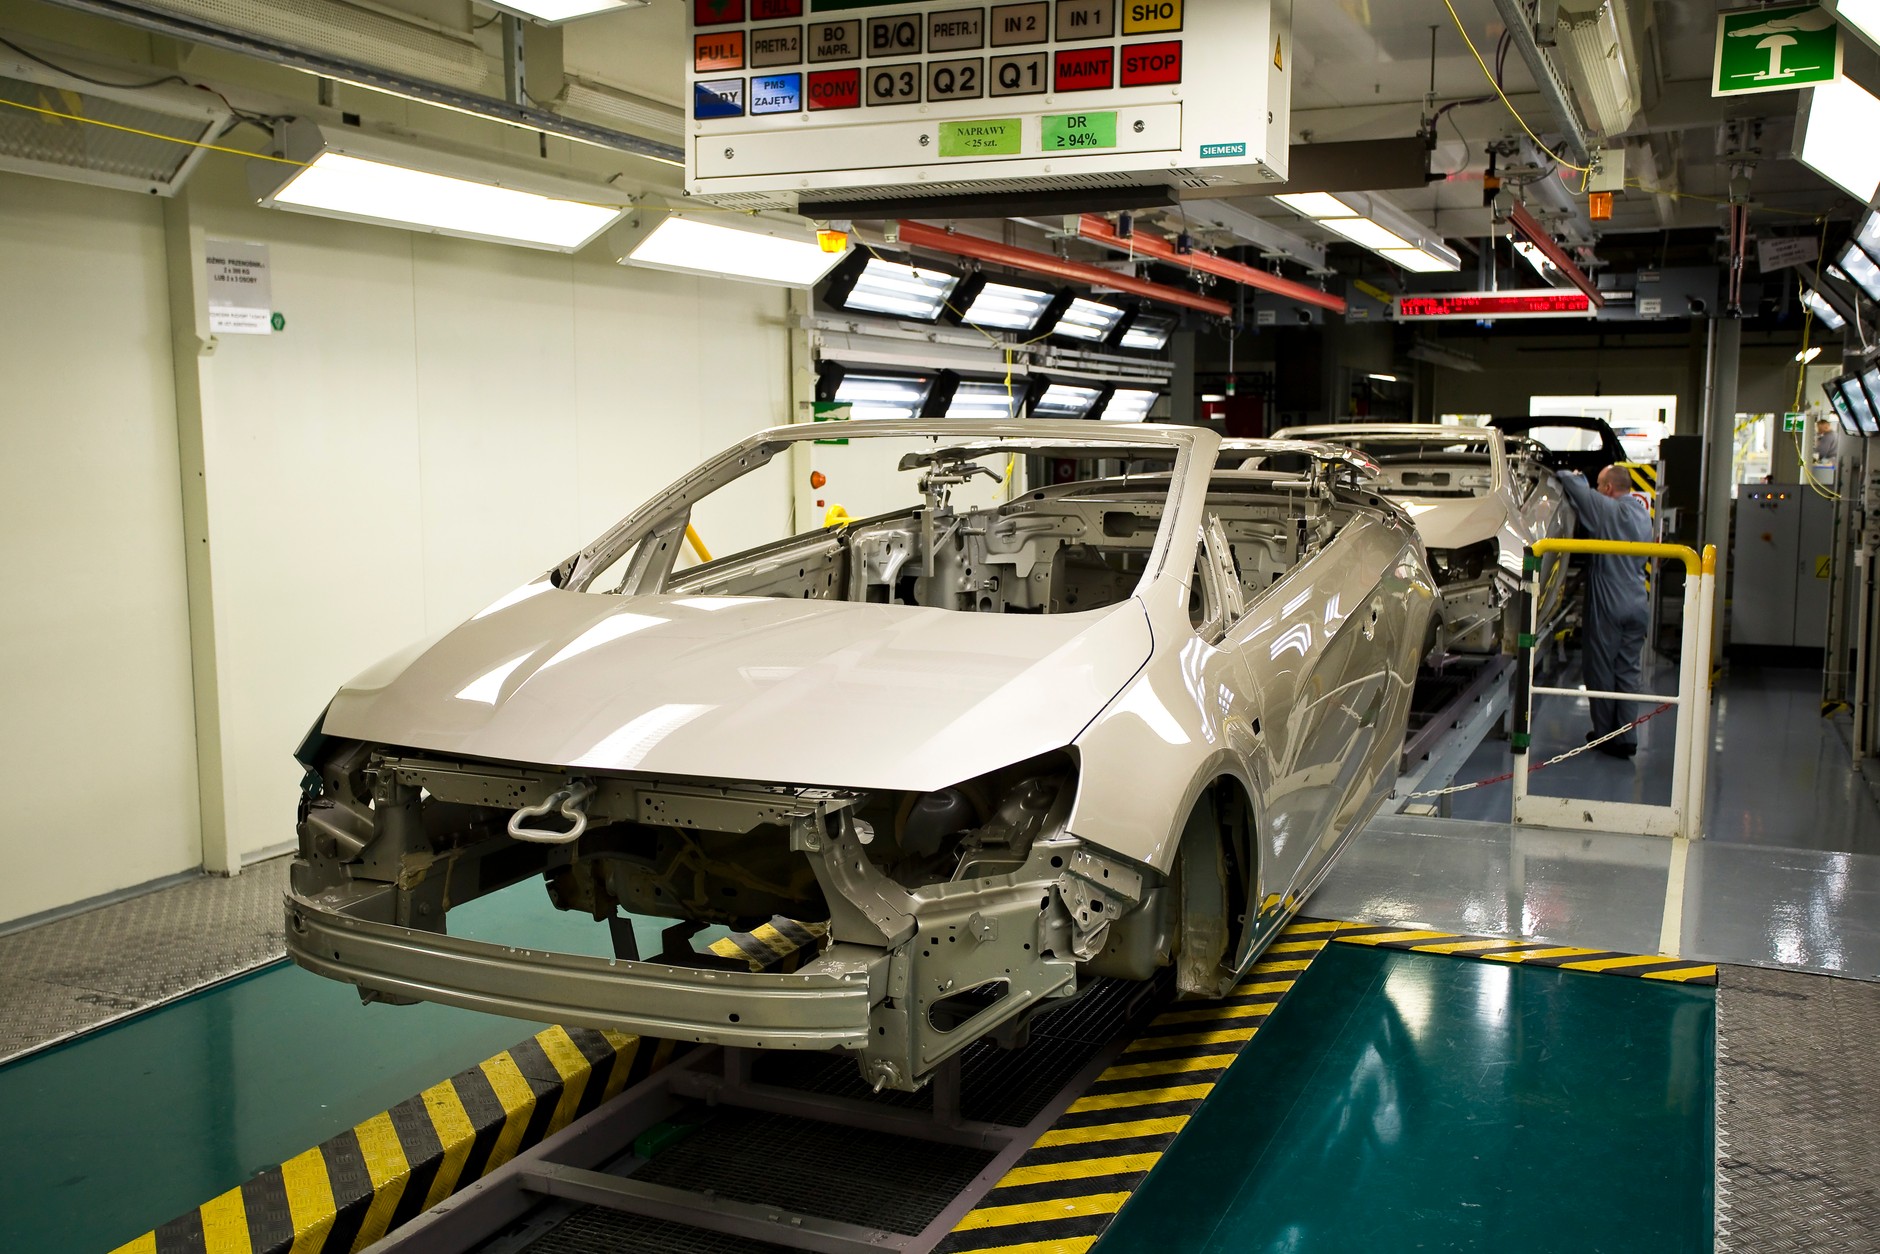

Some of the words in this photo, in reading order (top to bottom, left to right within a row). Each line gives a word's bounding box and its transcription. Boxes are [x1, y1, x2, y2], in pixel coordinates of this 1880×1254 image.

[1070, 10, 1088, 26] IN
[1094, 10, 1101, 24] 1
[1132, 3, 1174, 21] SHO
[1004, 17, 1021, 32] IN
[1026, 16, 1036, 31] 2
[823, 26, 845, 42] BO
[873, 21, 915, 49] B/Q
[698, 44, 740, 61] FULL
[817, 43, 851, 57] NAPR.
[1060, 60, 1109, 78] MAINT
[1126, 54, 1176, 72] STOP
[763, 80, 786, 90] PMS
[811, 80, 857, 98] CONV
[754, 95, 795, 108] ZAJĘTY
[1067, 116, 1087, 129] DR
[957, 126, 1006, 137] NAPRAWY
[1068, 132, 1098, 146] 94%
[972, 139, 982, 148] 25
[983, 139, 998, 147] szt.
[1202, 145, 1243, 155] SIEMENS
